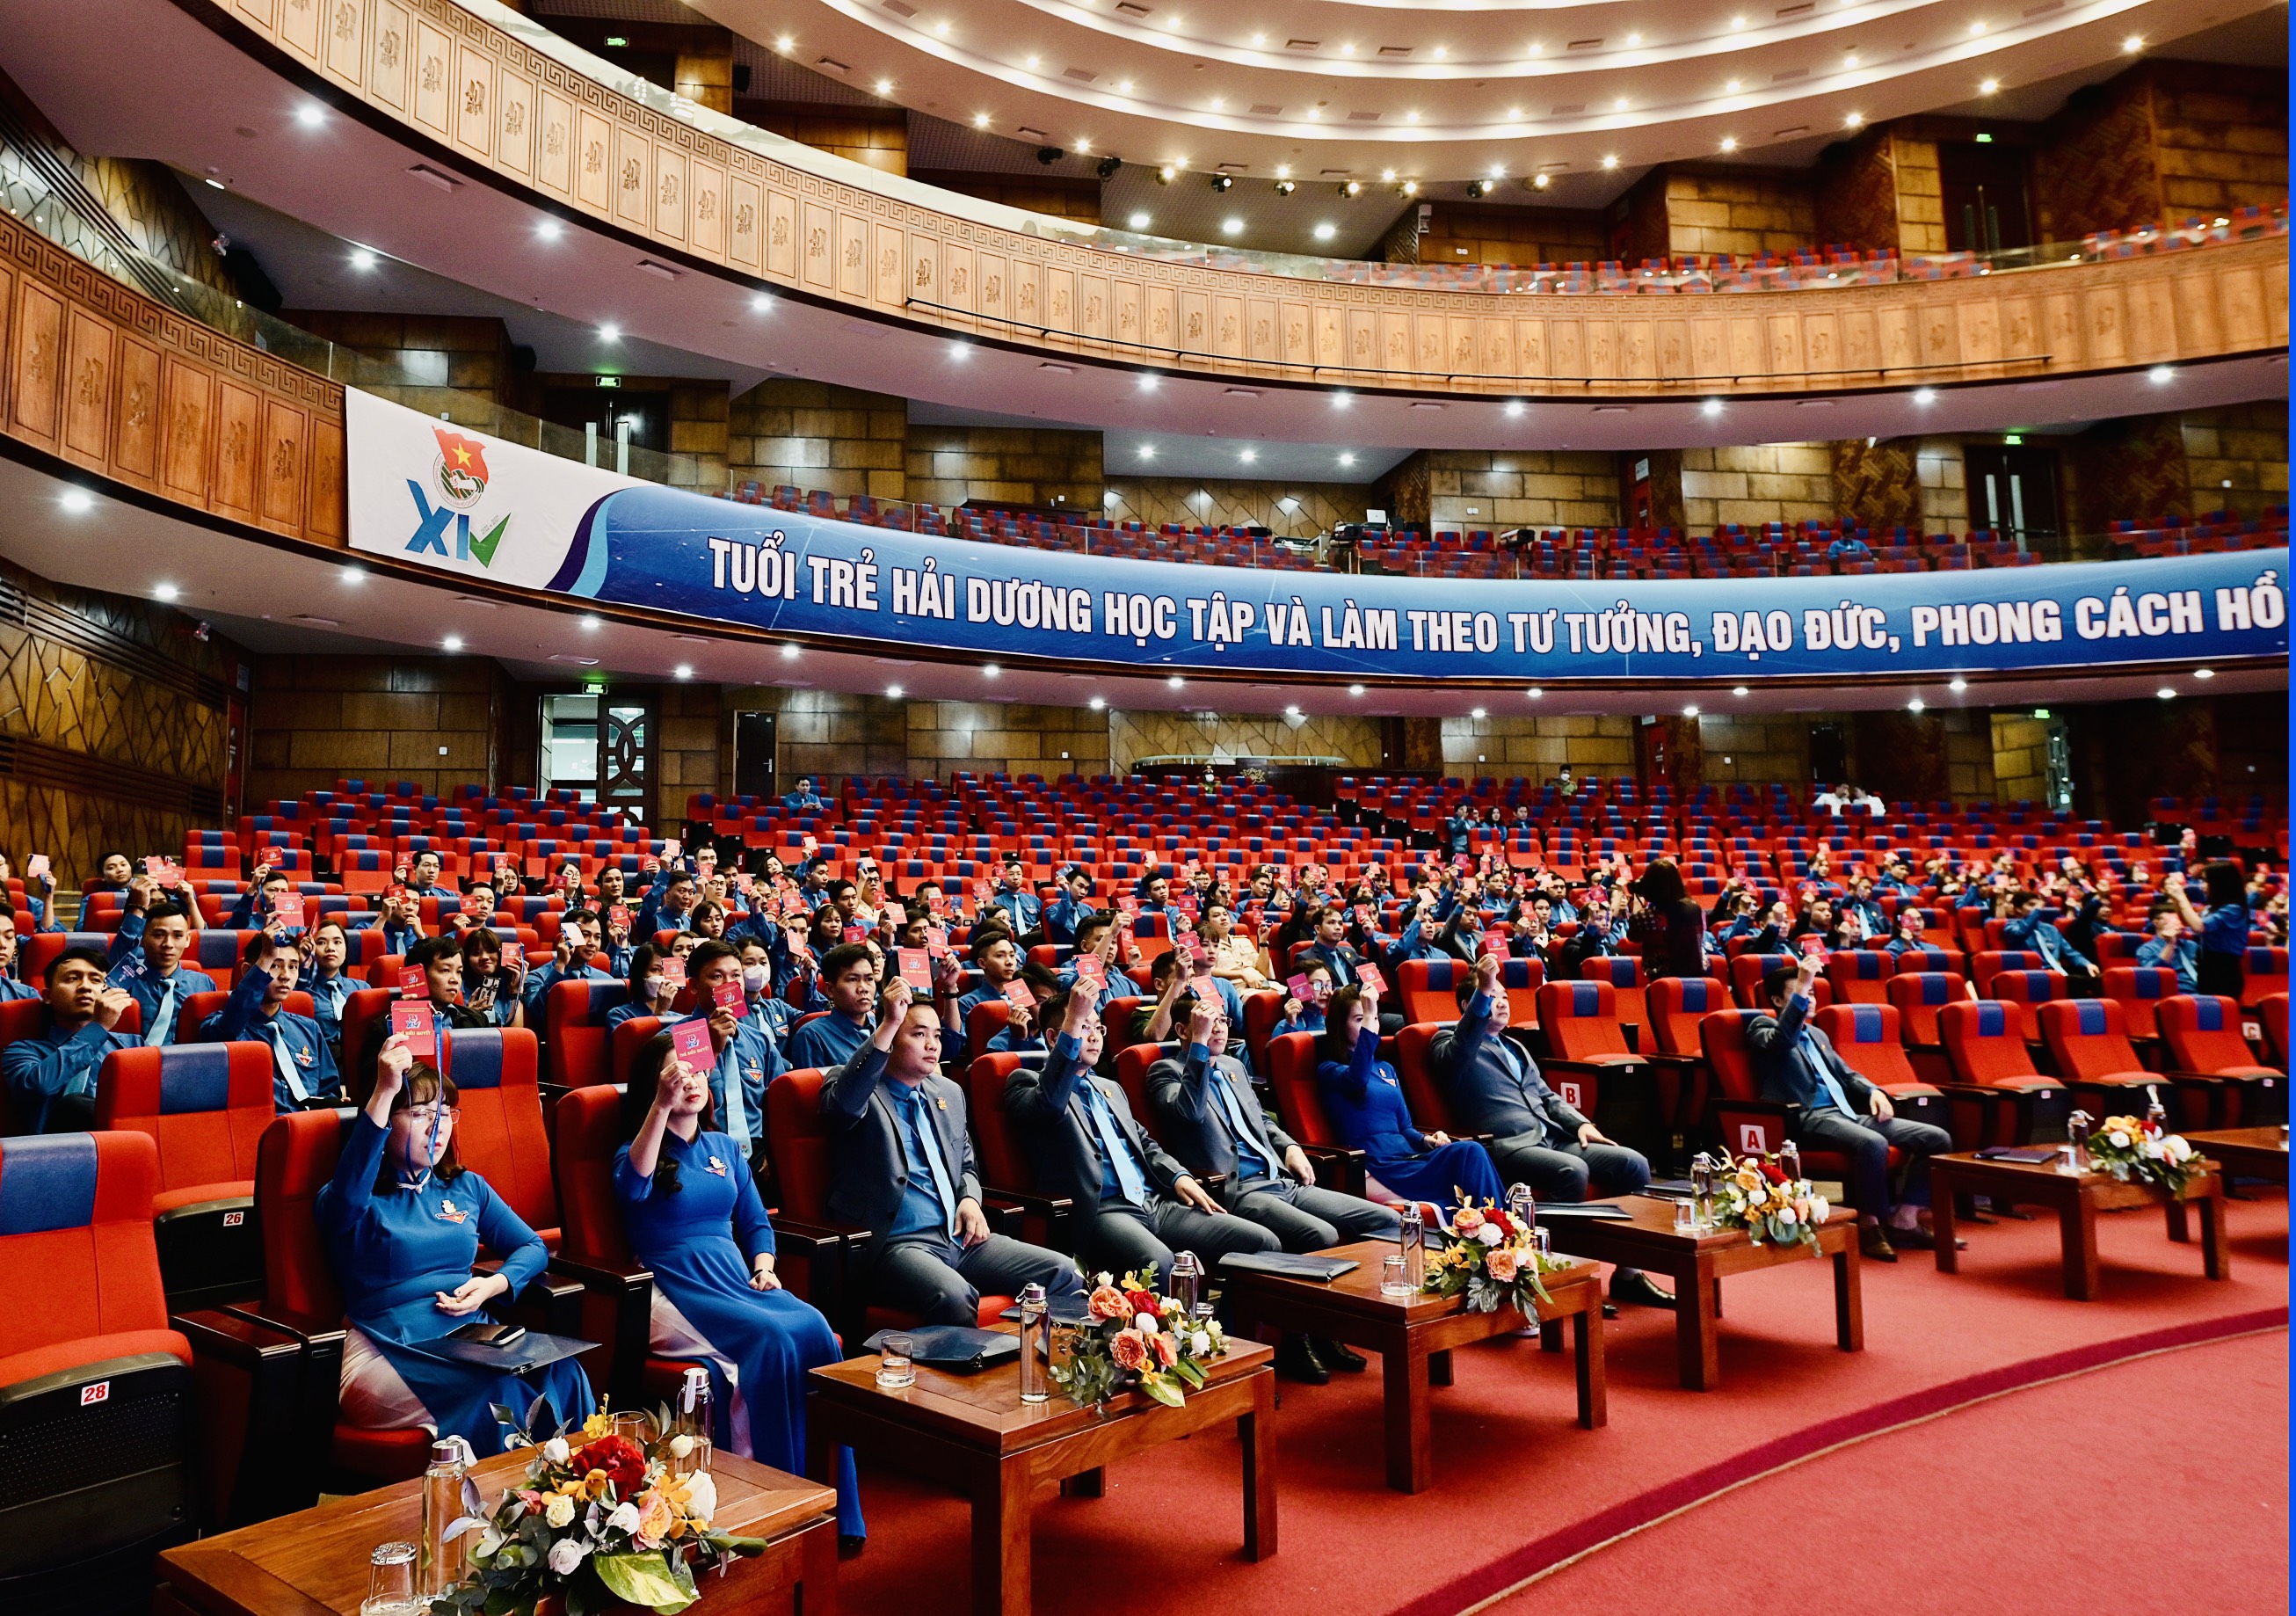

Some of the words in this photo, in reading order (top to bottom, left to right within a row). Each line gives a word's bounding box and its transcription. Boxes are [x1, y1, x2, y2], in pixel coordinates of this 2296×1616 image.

[708, 530, 796, 601] TUỔI
[807, 548, 879, 611] TRẺ
[891, 557, 955, 620] HẢI
[967, 578, 1092, 633] DƯƠNG
[1103, 592, 1176, 647] HỌC
[1186, 591, 1254, 651] TẬP
[1264, 596, 1312, 647] VÀ
[1321, 599, 1398, 651] LÀM
[1406, 610, 1499, 652] THEO
[1508, 608, 1559, 653] TƯ
[1564, 599, 1702, 657] TƯỞNG,
[1711, 611, 1792, 660] ĐẠO
[1803, 600, 1900, 653] ĐỨC,
[1910, 600, 2063, 647] PHONG
[2074, 586, 2204, 640] CÁCH
[2215, 570, 2286, 630] HỒ
[1566, 1087, 1576, 1104] B
[1747, 1130, 1761, 1149] A
[225, 1212, 242, 1225] 26
[84, 1384, 106, 1402] 28
